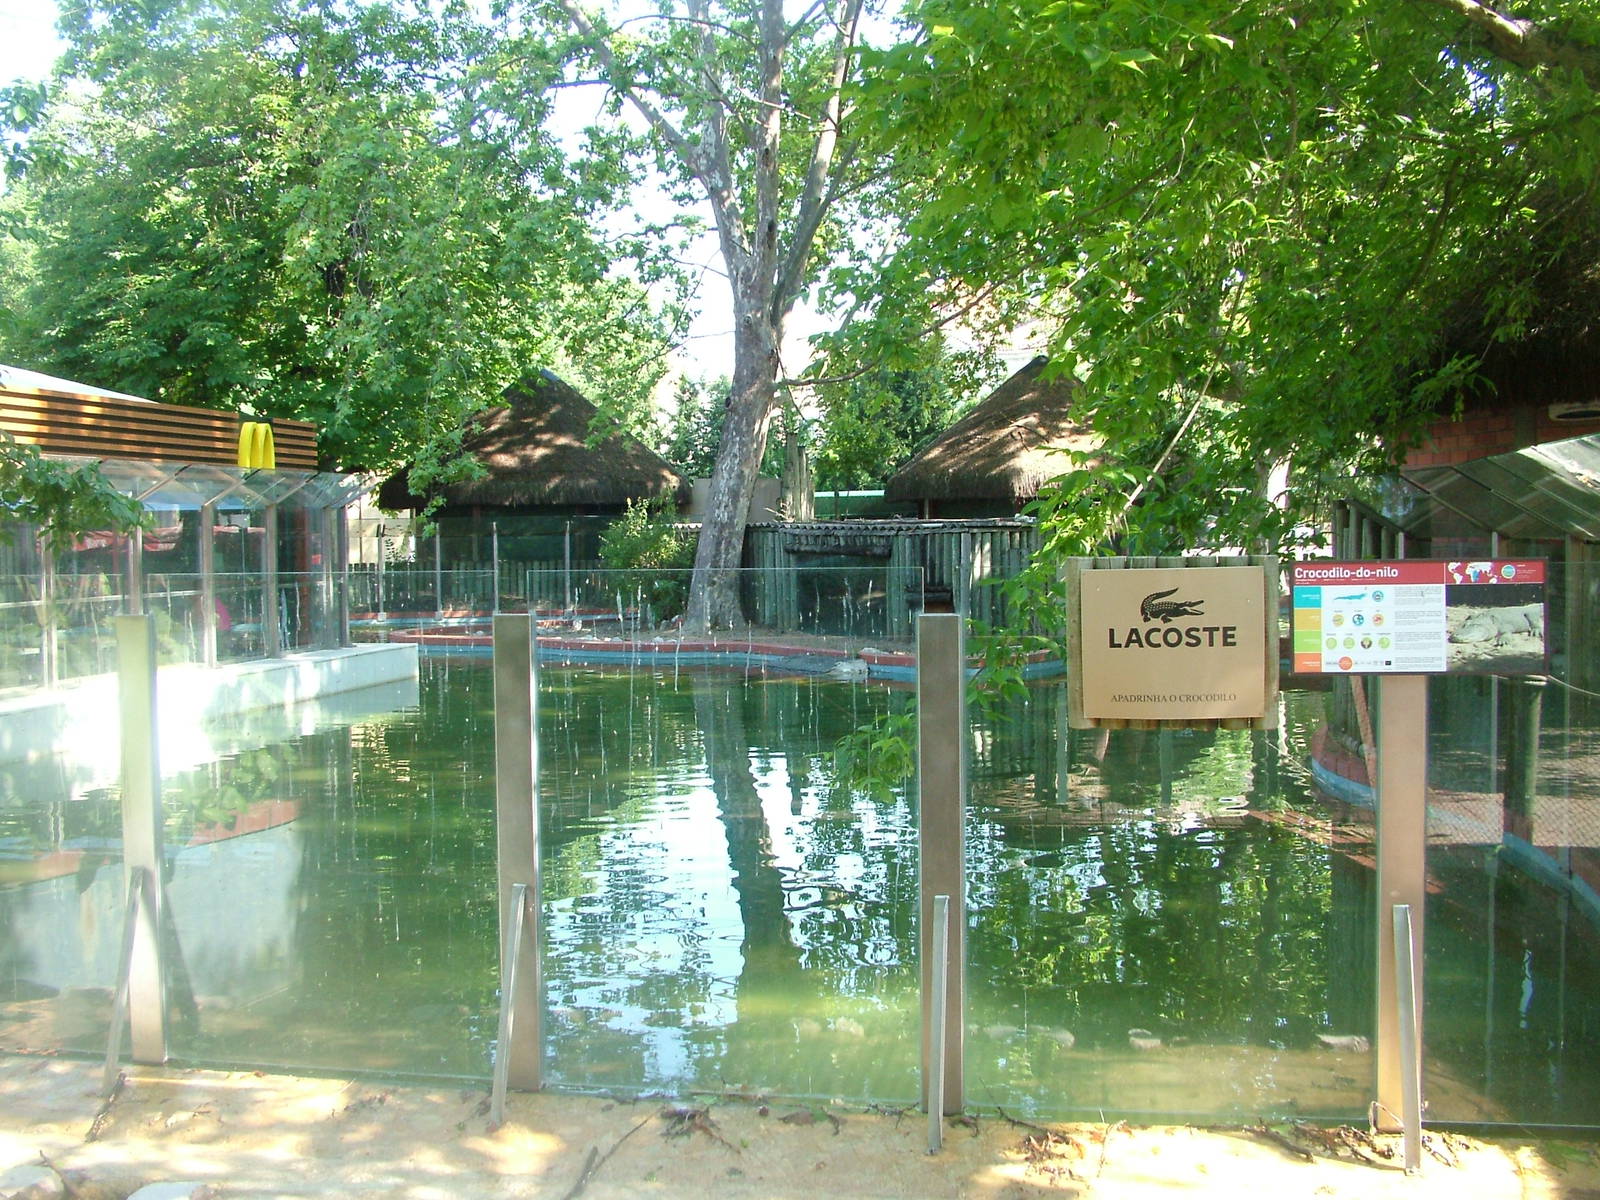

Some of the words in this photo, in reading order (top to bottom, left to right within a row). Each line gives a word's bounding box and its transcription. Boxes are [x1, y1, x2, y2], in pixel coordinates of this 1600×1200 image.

[1294, 566, 1399, 579] Crocodilo-do-nilo
[1108, 626, 1237, 649] LACOSTE
[1111, 694, 1167, 703] APADRINHA
[1169, 695, 1177, 703] O
[1178, 693, 1237, 703] CROCODILO
